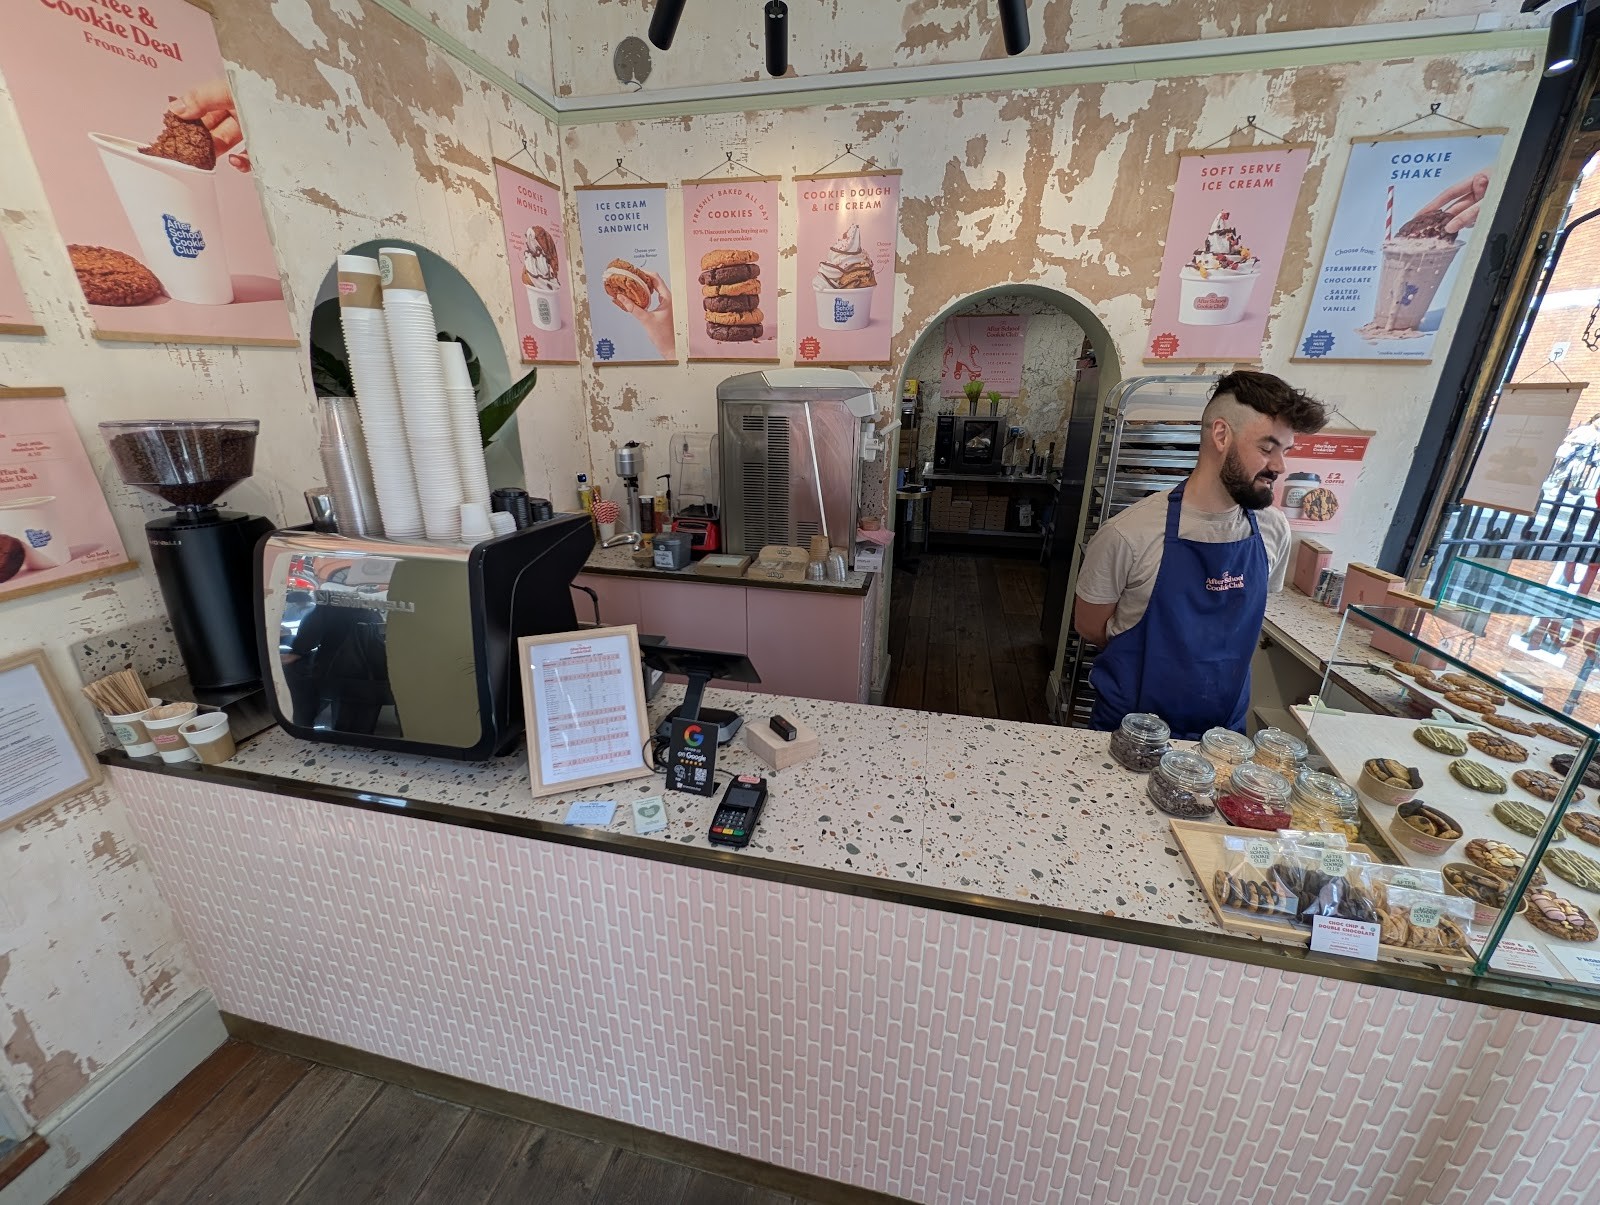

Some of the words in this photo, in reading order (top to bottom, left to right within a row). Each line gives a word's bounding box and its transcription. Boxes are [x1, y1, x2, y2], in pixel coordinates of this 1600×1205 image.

[138, 6, 158, 29] &
[129, 24, 183, 62] Deal
[83, 31, 125, 57] From
[126, 48, 158, 68] 5.40
[1391, 152, 1453, 164] COOKIE
[1201, 165, 1234, 177] SOFT
[1240, 163, 1282, 175] SERVE
[1391, 168, 1442, 180] SHAKE
[1202, 181, 1222, 191] ICE
[1229, 179, 1274, 190] CREAM
[517, 185, 543, 203] COOKIE
[804, 190, 845, 200] COOKIE
[850, 187, 891, 197] DOUGH
[516, 197, 548, 216] MONSTER
[596, 202, 611, 210] ICE
[615, 200, 647, 210] CREAM
[693, 193, 714, 224] FRESHLY
[718, 189, 742, 197] BAKED
[745, 192, 758, 203] ALL
[759, 204, 769, 222] DAY
[811, 203, 819, 212] &
[824, 203, 840, 211] ICE
[845, 200, 882, 210] CREAM
[604, 212, 641, 222] COOKIE
[708, 210, 753, 219] COOKIES
[167, 219, 191, 231] After
[598, 223, 649, 234] SANDWICH
[168, 228, 203, 239] School
[172, 237, 206, 248] Cookie
[176, 246, 200, 256] Club
[1206, 577, 1225, 585] After
[686, 752, 707, 763] Google
[1342, 928, 1375, 937] CHOCOLATE
